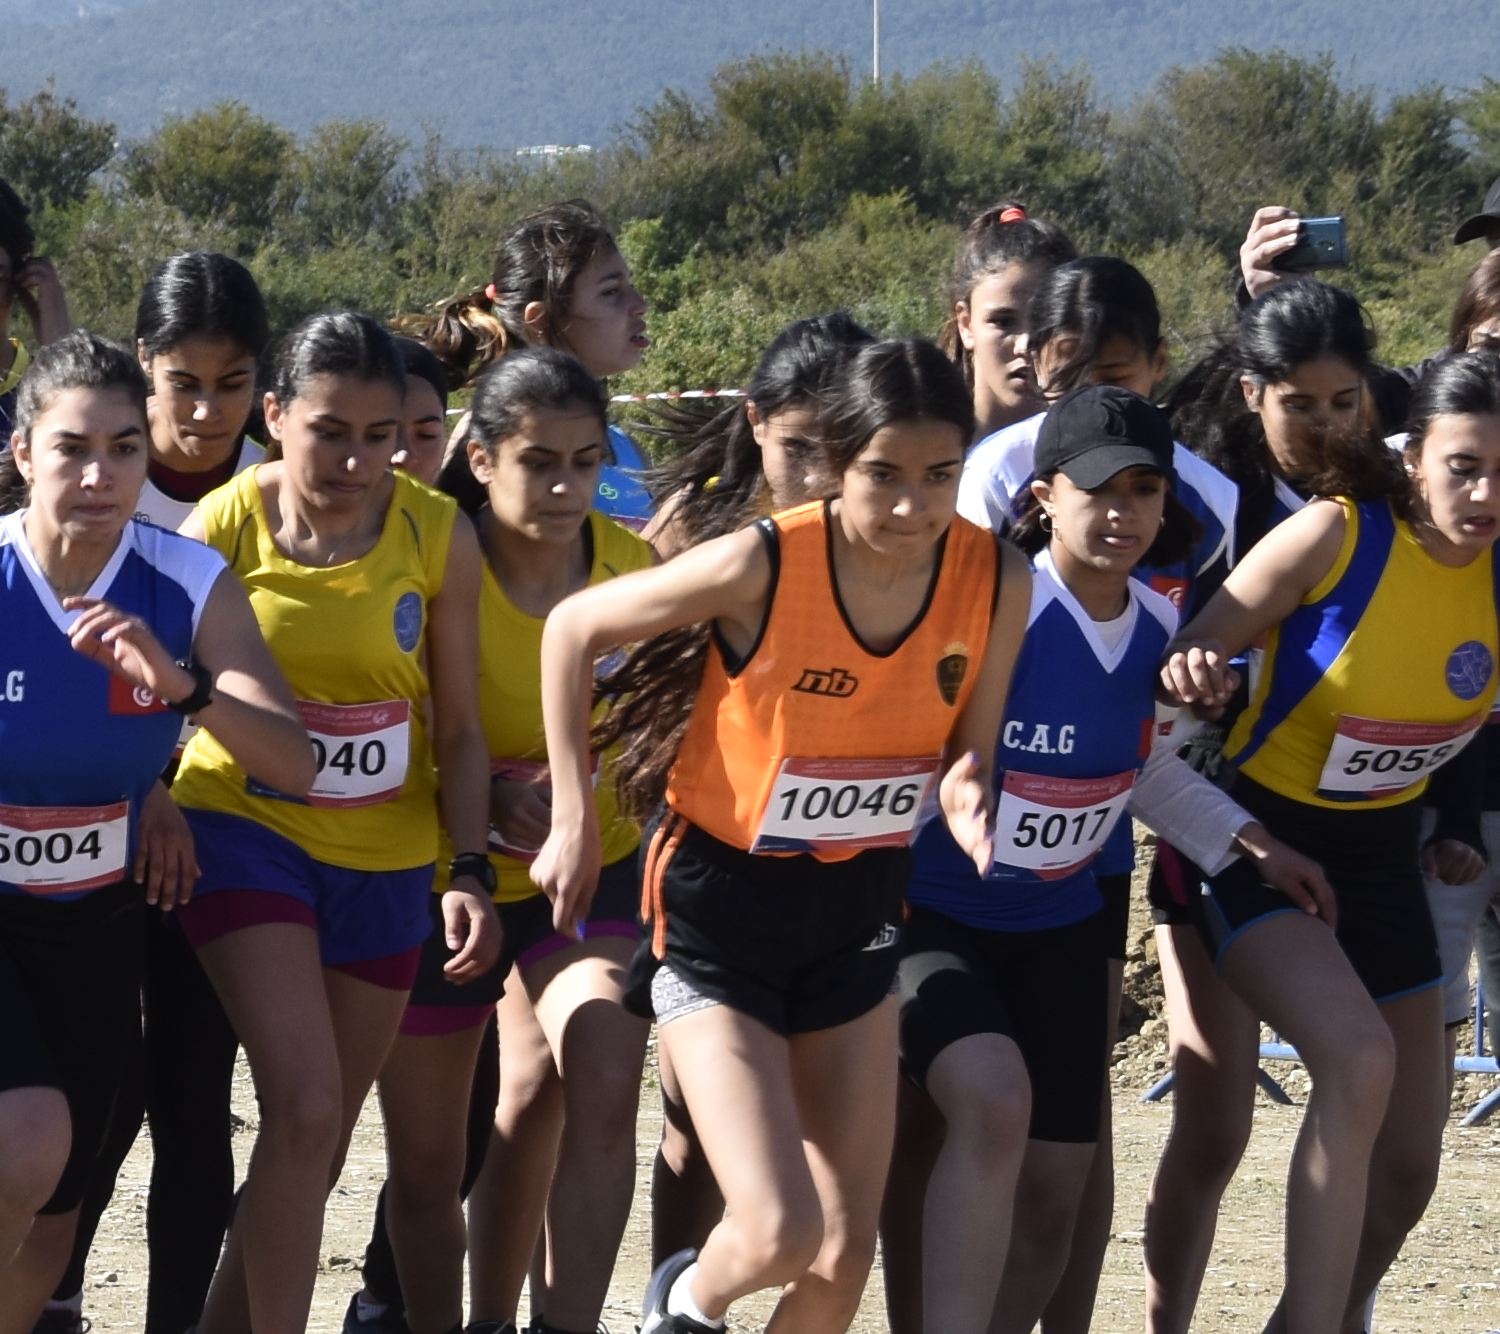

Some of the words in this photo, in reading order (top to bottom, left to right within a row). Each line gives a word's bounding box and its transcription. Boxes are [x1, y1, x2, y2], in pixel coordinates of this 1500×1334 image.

[1003, 720, 1075, 754] C.A.G
[779, 783, 919, 822] 10046
[1012, 806, 1112, 849] 5017
